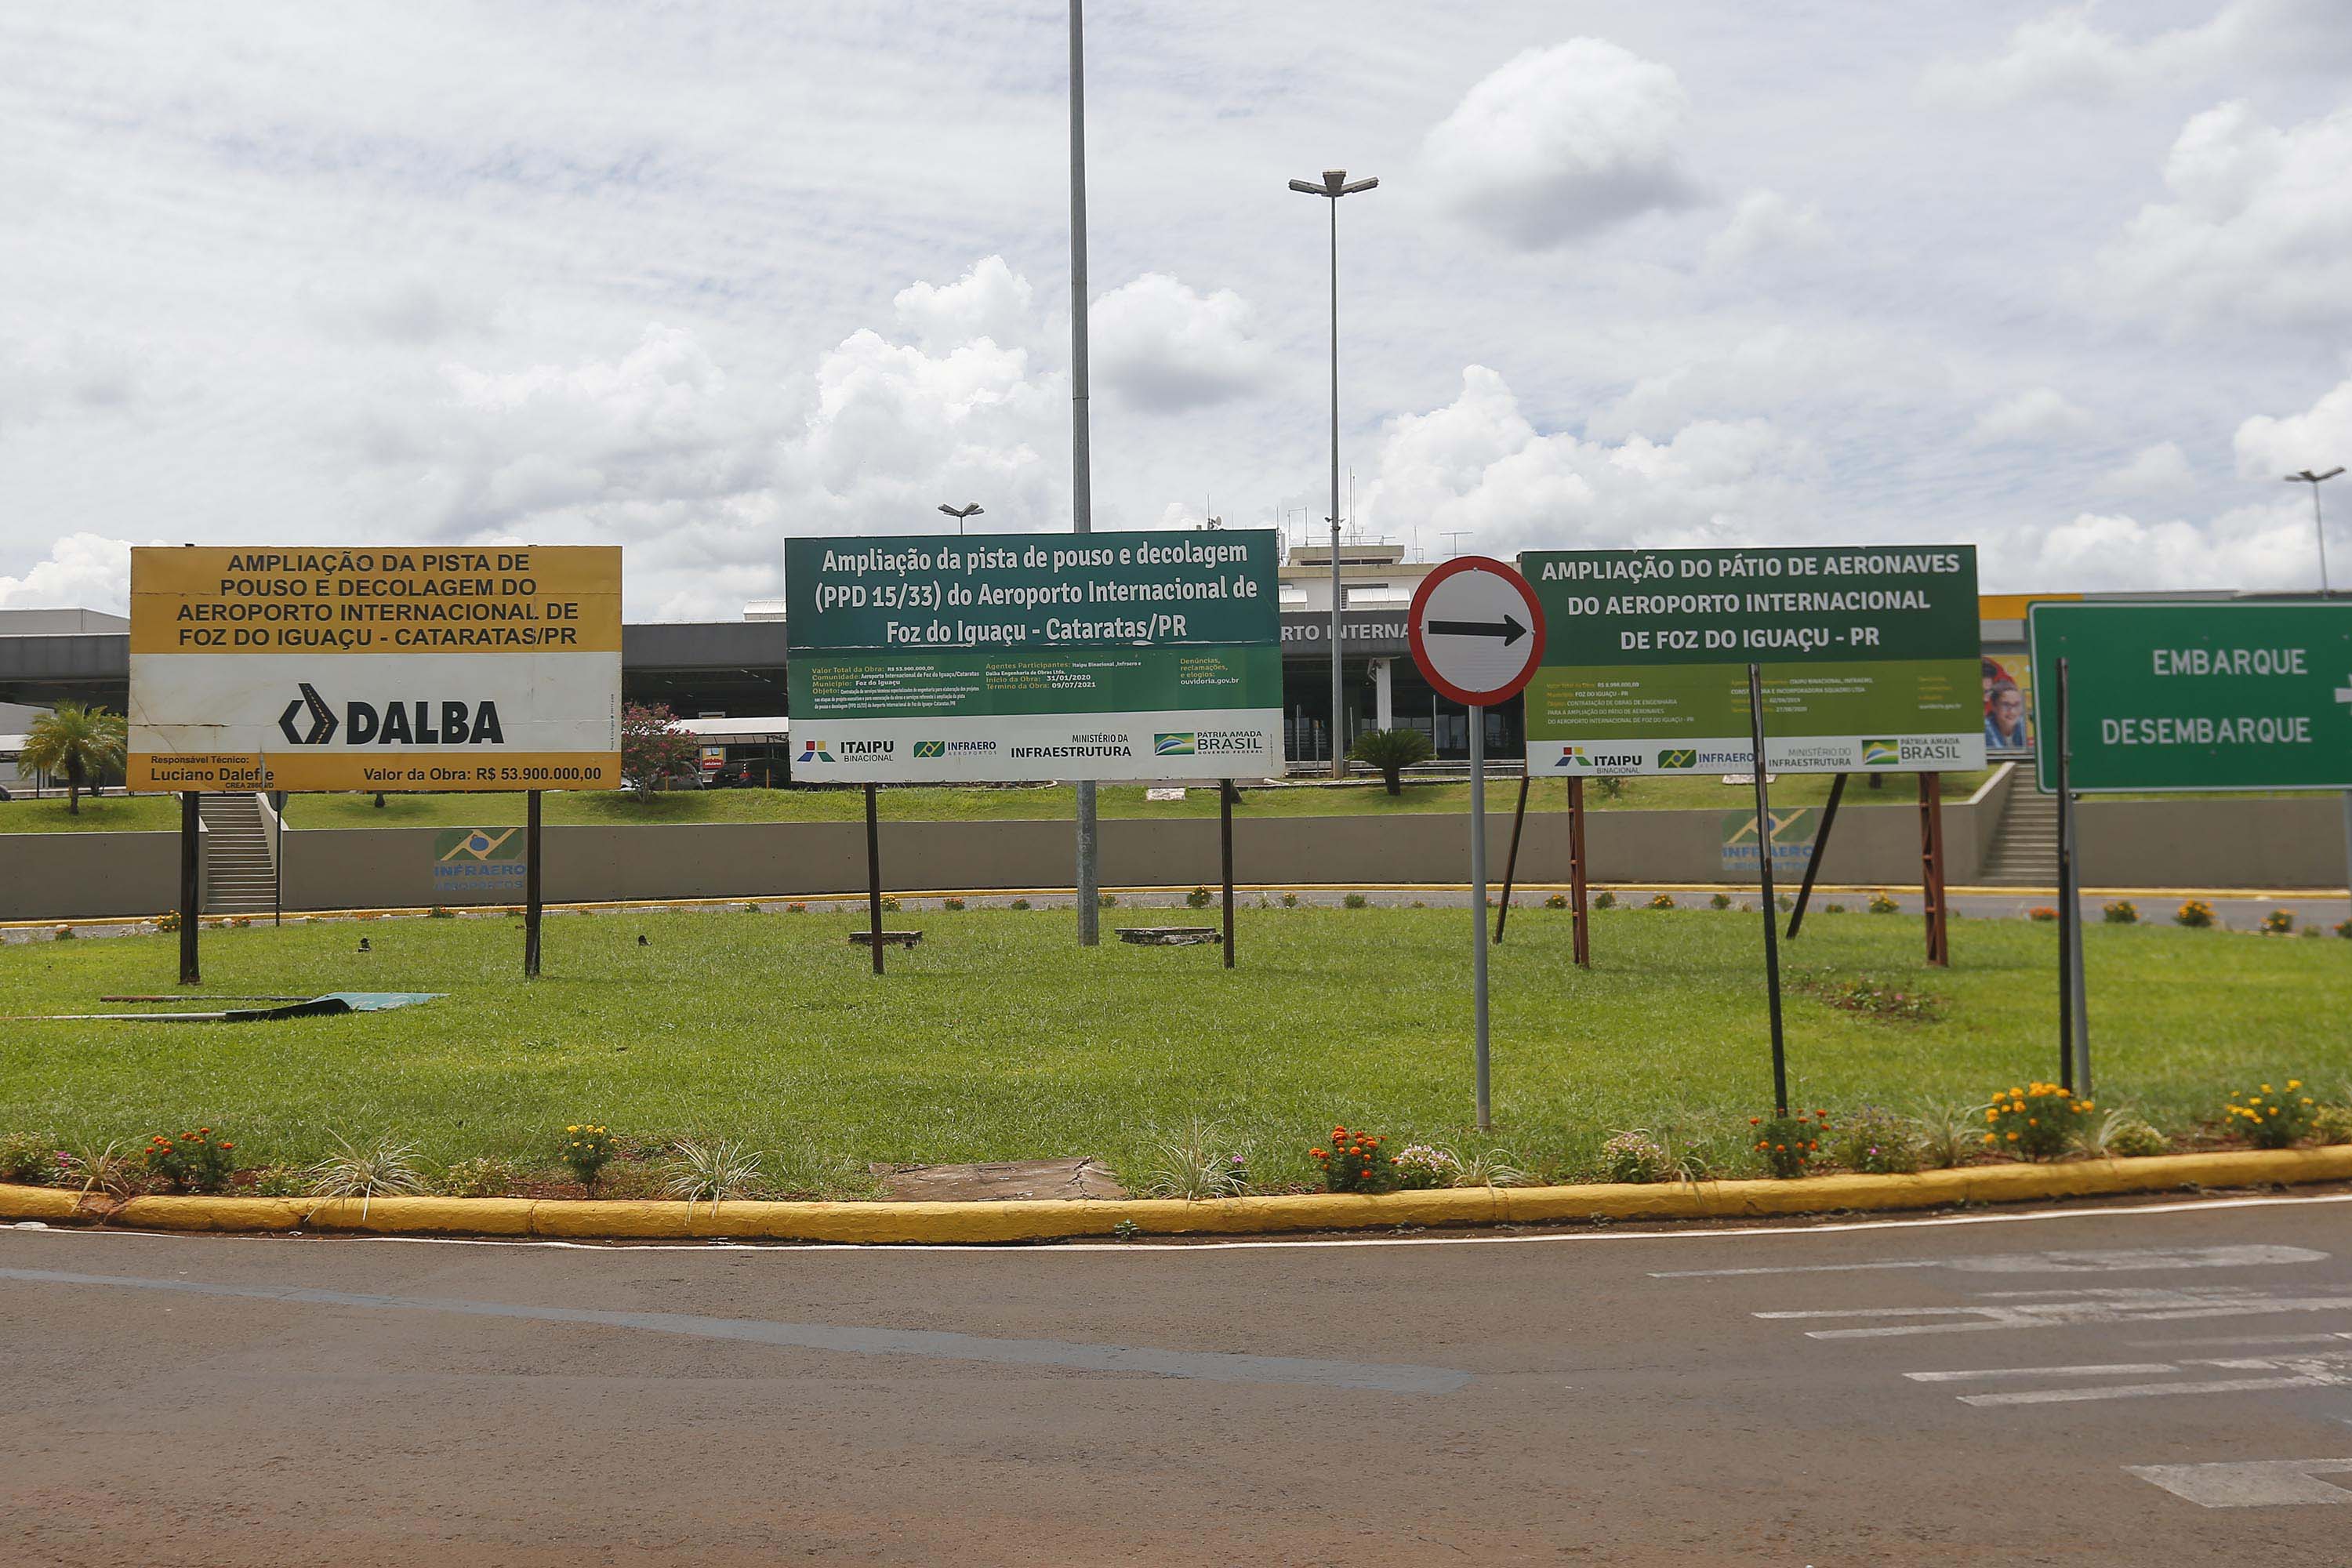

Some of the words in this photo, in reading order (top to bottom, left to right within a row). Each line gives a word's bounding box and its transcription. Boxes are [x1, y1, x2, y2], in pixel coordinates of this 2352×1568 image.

[227, 551, 374, 575] AMPLIAÇÃO
[383, 554, 416, 571] DA
[423, 554, 491, 571] PISTA
[498, 554, 529, 571] DE
[822, 548, 931, 577] Ampliação
[937, 547, 960, 569] da
[967, 547, 1018, 575] pista
[1024, 545, 1047, 568] de
[1054, 548, 1113, 573] pouso
[1120, 548, 1131, 564] e
[1137, 540, 1248, 568] decolagem
[1541, 555, 1675, 584] AMPLIAÇÃO
[1681, 560, 1712, 578] DO
[1719, 554, 1781, 577] PÁTIO
[1788, 557, 1817, 575] DE
[1823, 554, 1960, 575] AERONAVES
[221, 579, 307, 597] POUSO
[316, 579, 329, 596] E
[339, 579, 493, 597] DECOLAGEM
[502, 579, 536, 596] DO
[815, 582, 866, 613] (PPD
[872, 580, 941, 612] 15/33)
[947, 583, 972, 605] do
[978, 583, 1082, 610] Aeroporto
[1089, 575, 1228, 602] Internacional
[1232, 575, 1258, 597] de
[1568, 597, 1599, 615] DO
[1605, 594, 1740, 614] AEROPORTO
[1746, 590, 1931, 612] INTERNACIONAL
[176, 604, 332, 621] AEROPORTO
[341, 603, 539, 621] INTERNACIONAL
[547, 603, 578, 619] DE
[887, 621, 920, 643] Foz
[927, 619, 951, 642] do
[958, 621, 1025, 646] Iguaçu
[1046, 613, 1187, 641] Cataratas/PR
[180, 629, 227, 646] FOZ
[235, 629, 269, 645] DO
[278, 629, 372, 650] IGUAÇU
[395, 627, 577, 645] CATARATAS/PR
[1621, 631, 1650, 649] DE
[1657, 630, 1698, 649] FOZ
[1705, 630, 1737, 648] DO
[1744, 628, 1829, 652] IGUAÇU
[1850, 627, 1879, 645] PR
[2153, 649, 2308, 676] EMBARQUE
[347, 701, 504, 744] DALBA
[1072, 732, 1115, 743] MINISTÉRIO
[2102, 717, 2311, 745] DESEMBARQUE
[841, 740, 894, 754] ITAIPU
[948, 742, 996, 750] INFRAERO
[1198, 739, 1262, 750] BRASIL
[1788, 746, 1837, 757] MINISTÉRIO
[1838, 747, 1851, 756] DO
[1011, 746, 1131, 758] INFRAESTRUTURA
[1699, 753, 1755, 762] INFRAERO
[1901, 746, 1960, 759] BRASIL
[151, 756, 208, 765] Responsável
[1594, 756, 1642, 766] ITAIPU
[1769, 758, 1851, 767] INFRAESTRUTURA
[151, 768, 213, 780] Luciano
[220, 768, 274, 780] Dalefe
[364, 768, 403, 780] Valor
[408, 768, 425, 780] da
[430, 768, 470, 780] Obra:
[477, 768, 496, 781] R$
[501, 768, 601, 782] 53.900.000,00
[434, 865, 526, 877] INFRAERO
